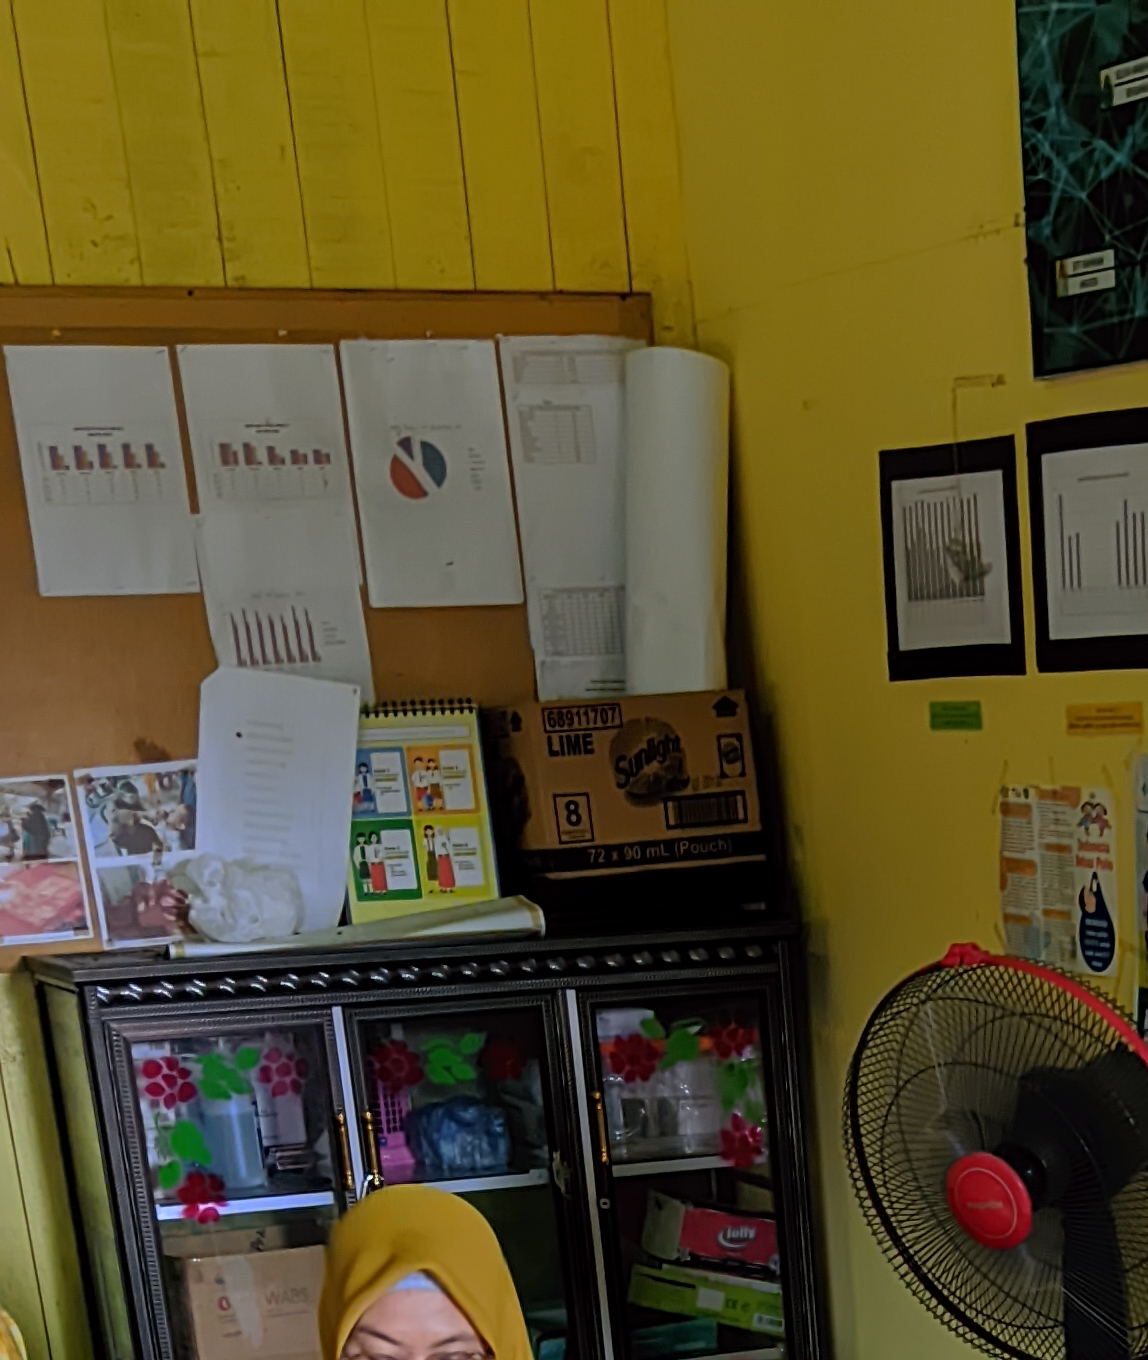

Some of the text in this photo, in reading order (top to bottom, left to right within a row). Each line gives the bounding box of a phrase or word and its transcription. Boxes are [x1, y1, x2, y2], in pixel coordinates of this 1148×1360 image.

[547, 707, 616, 728] 68911707
[547, 733, 595, 757] LIME
[615, 734, 682, 789] Sunlight
[564, 800, 582, 827] 8
[588, 848, 606, 864] 72
[674, 837, 733, 857] (Pouch)
